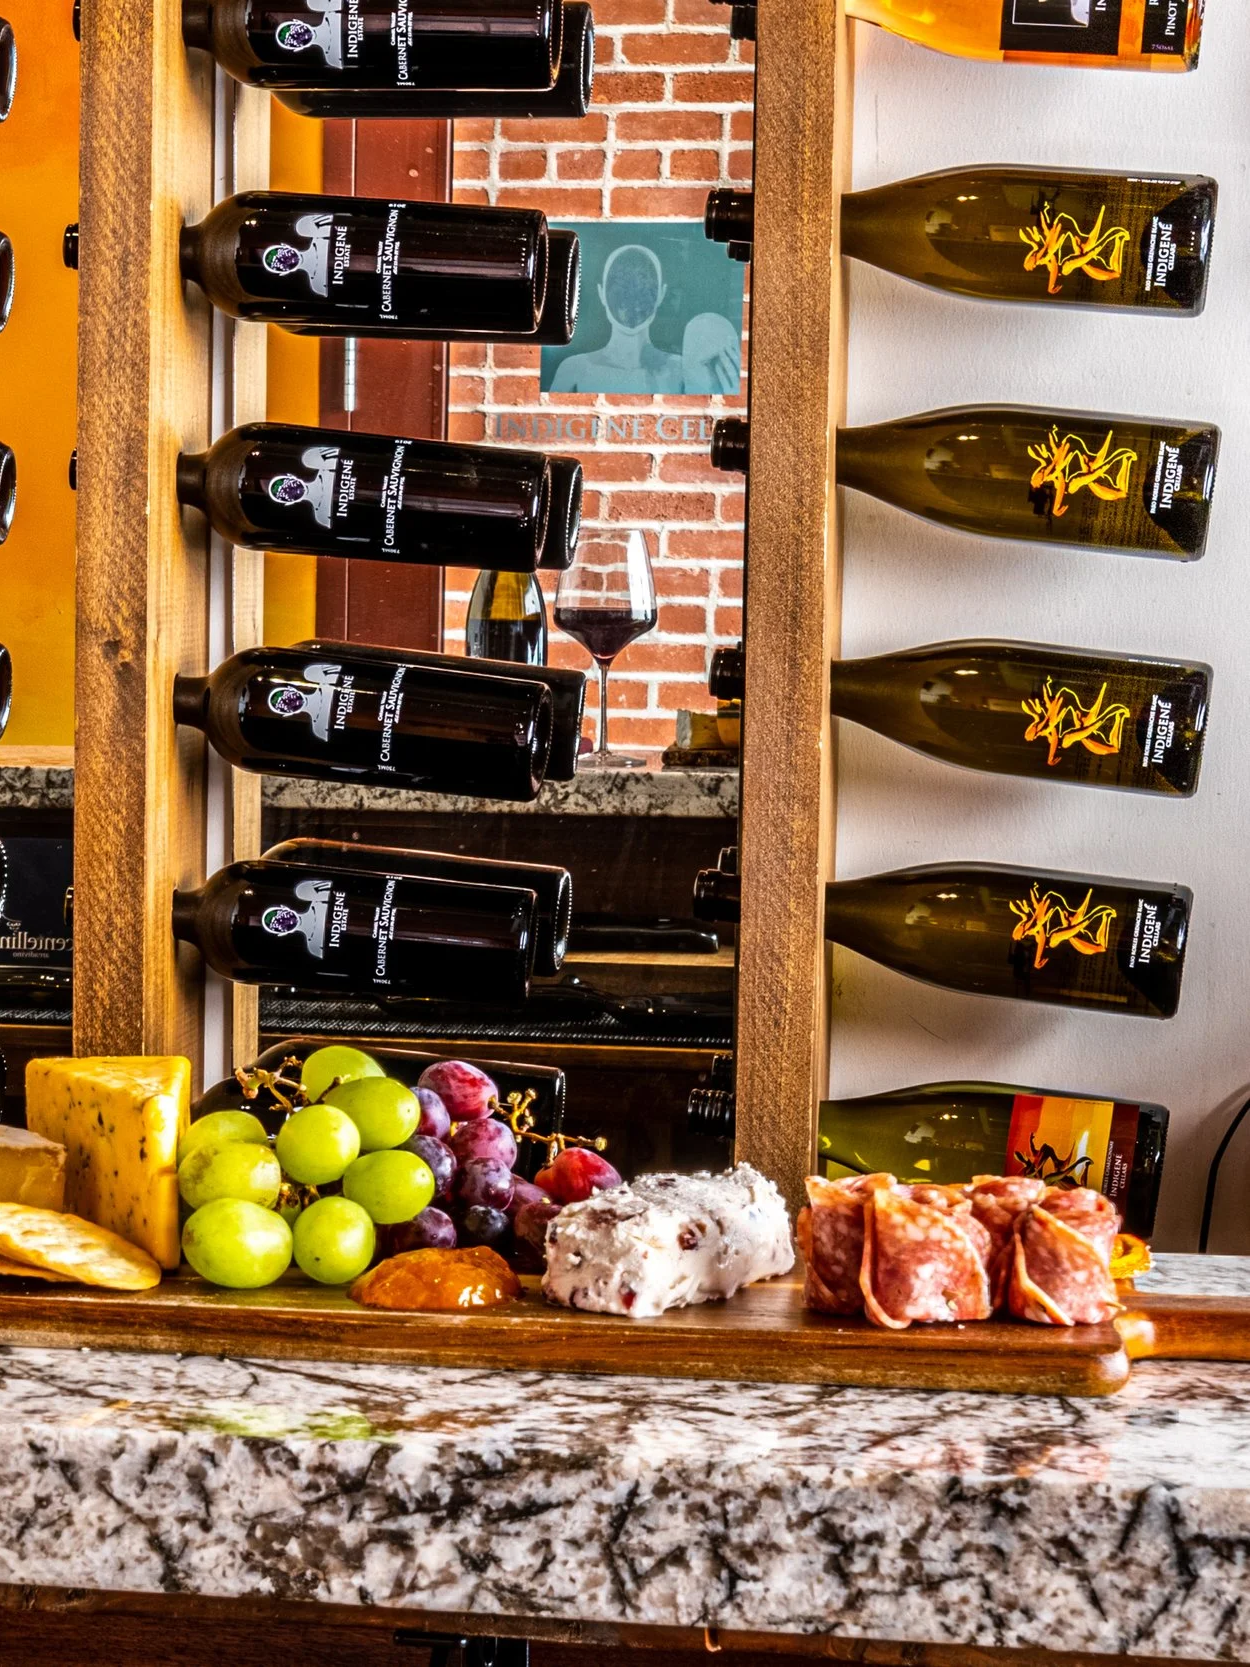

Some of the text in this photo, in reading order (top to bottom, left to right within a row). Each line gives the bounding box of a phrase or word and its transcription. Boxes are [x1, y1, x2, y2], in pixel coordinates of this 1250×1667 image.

[1165, 1, 1177, 36] PINOT
[398, 36, 408, 80] CABERNET
[332, 226, 347, 285] INDIGENÉ
[383, 209, 399, 261] SAUVIGNON
[1154, 222, 1172, 286] INDIGENÉ
[1168, 243, 1176, 271] CELLARS
[381, 263, 392, 312] CABERNET
[656, 415, 713, 441] CEL
[336, 459, 353, 517] INDIGENÉ
[349, 477, 357, 500] ESTATE
[387, 445, 405, 496] SAUVIGNON
[1159, 445, 1179, 509] INDIGENÉ
[1174, 465, 1183, 491] CELLARS
[384, 498, 397, 546] CABERNET
[385, 667, 406, 710] SAUVIGNON
[380, 712, 394, 762] CABERNET
[1152, 700, 1172, 763] INDIGENÉ
[1166, 721, 1175, 748] CELLARS
[329, 890, 345, 947] INDIGENÉ
[341, 909, 349, 931] ESTATE
[379, 880, 396, 927] SAUVIGNON
[376, 929, 388, 976] CABERNET
[1138, 903, 1157, 963] INDIGENÉ
[1152, 921, 1161, 946] CELLARS
